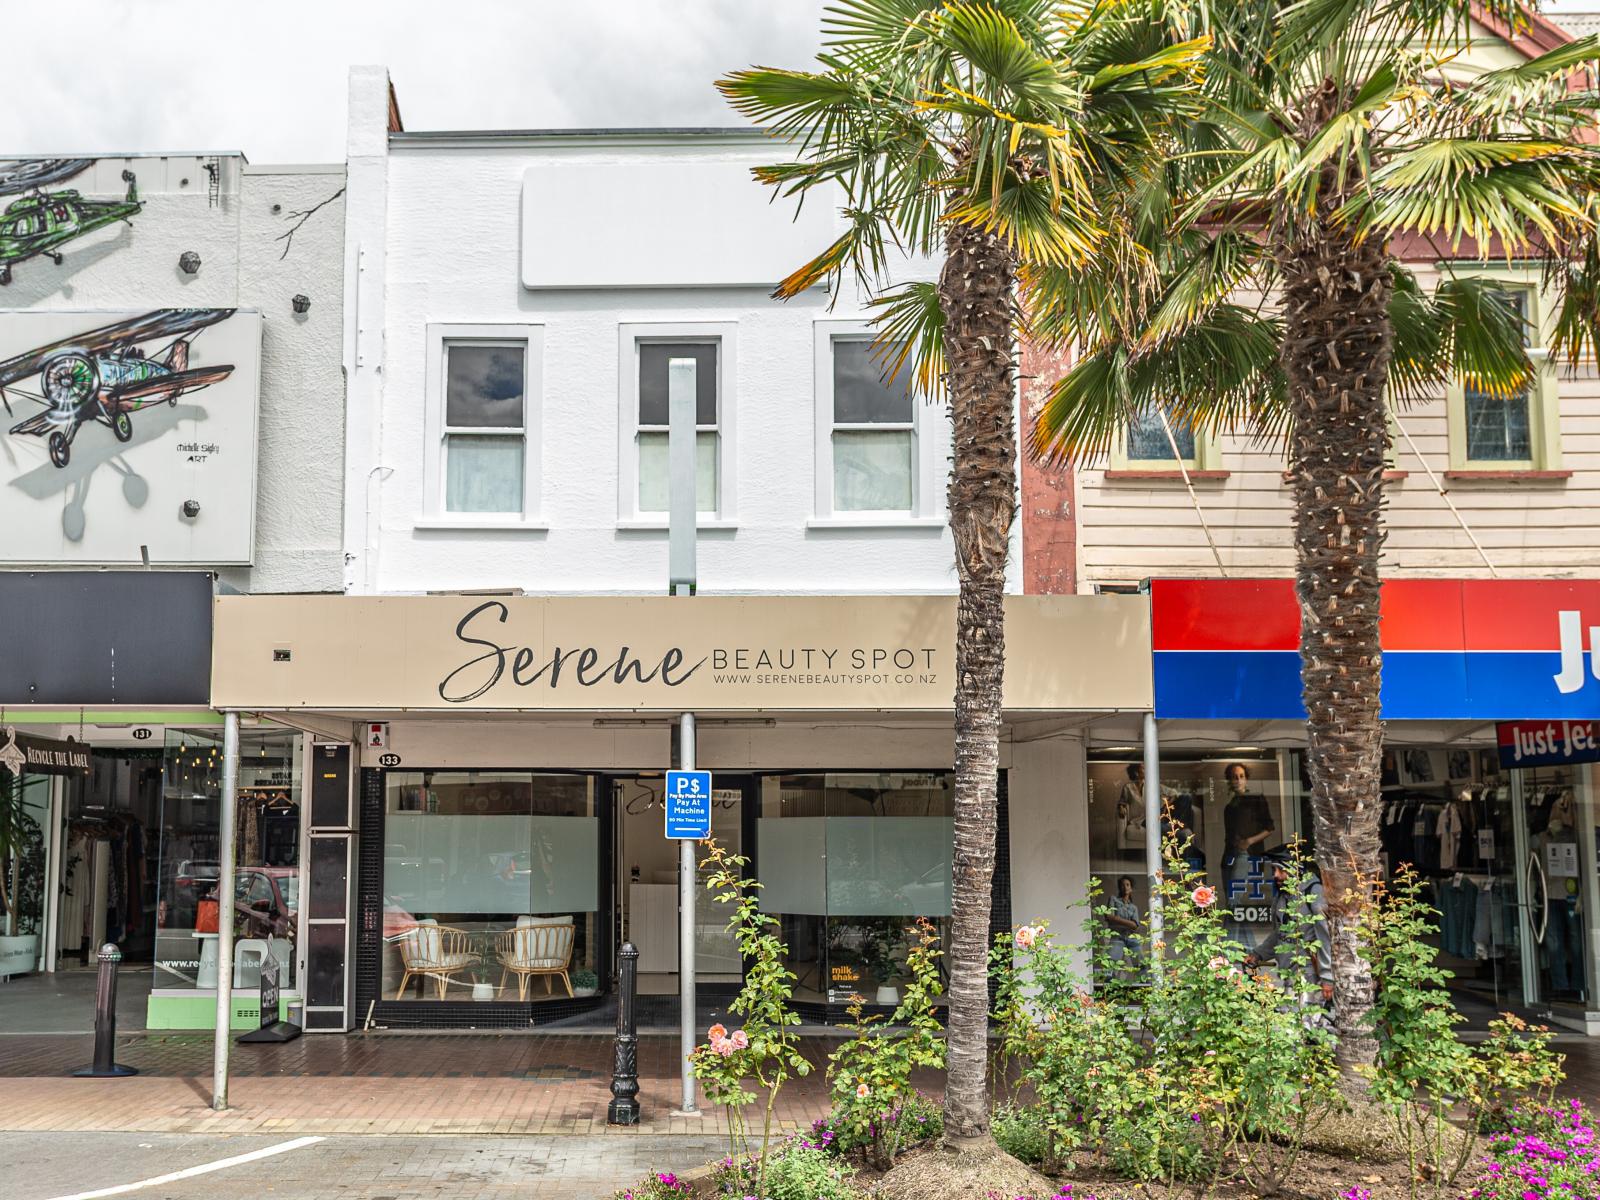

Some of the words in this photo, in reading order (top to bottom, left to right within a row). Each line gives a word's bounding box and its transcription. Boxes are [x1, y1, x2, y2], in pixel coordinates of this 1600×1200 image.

[186, 455, 208, 463] ART
[439, 601, 708, 702] Serene
[1553, 610, 1600, 694] J
[713, 648, 838, 670] BEAUTY
[851, 648, 937, 670] SPOT
[713, 674, 937, 684] WWW.SERENEBEAUTYSPOT.CO.NZ
[135, 730, 150, 738] 131
[1513, 723, 1558, 761] Just
[381, 756, 398, 765] 133
[676, 799, 690, 807] Pay
[674, 806, 705, 815] Machine
[832, 966, 851, 974] milk
[262, 985, 279, 1008] OPEN
